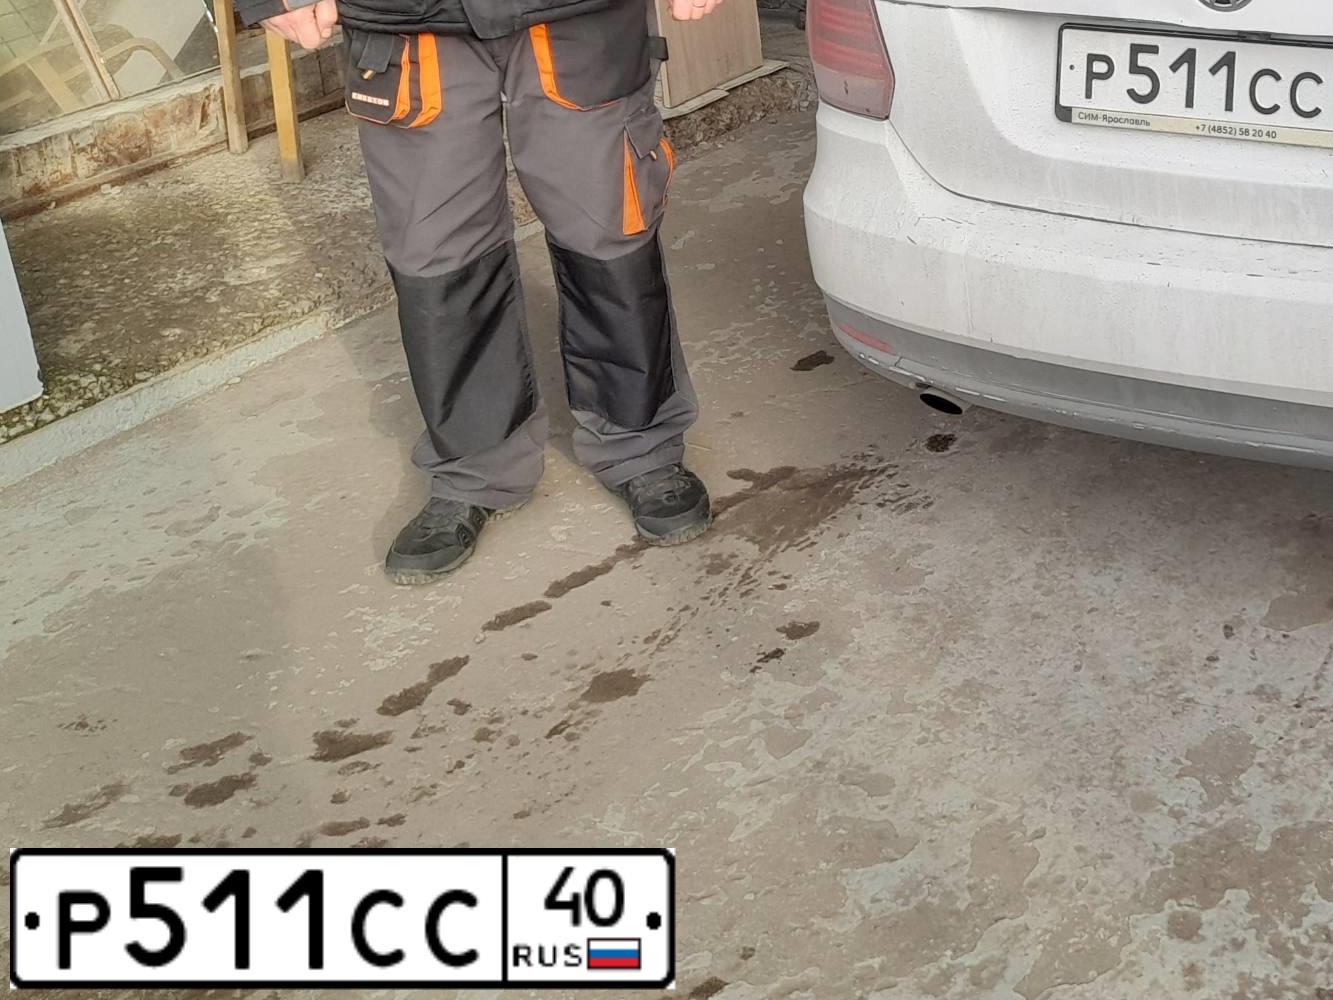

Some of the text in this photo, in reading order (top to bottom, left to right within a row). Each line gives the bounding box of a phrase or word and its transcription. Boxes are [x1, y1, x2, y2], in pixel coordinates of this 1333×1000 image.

[1078, 111, 1150, 127] СИМ-Ярославль
[1195, 123, 1206, 132] +7
[1207, 124, 1237, 136] (4852)
[1251, 129, 1264, 138] 20
[1265, 130, 1277, 139] 40
